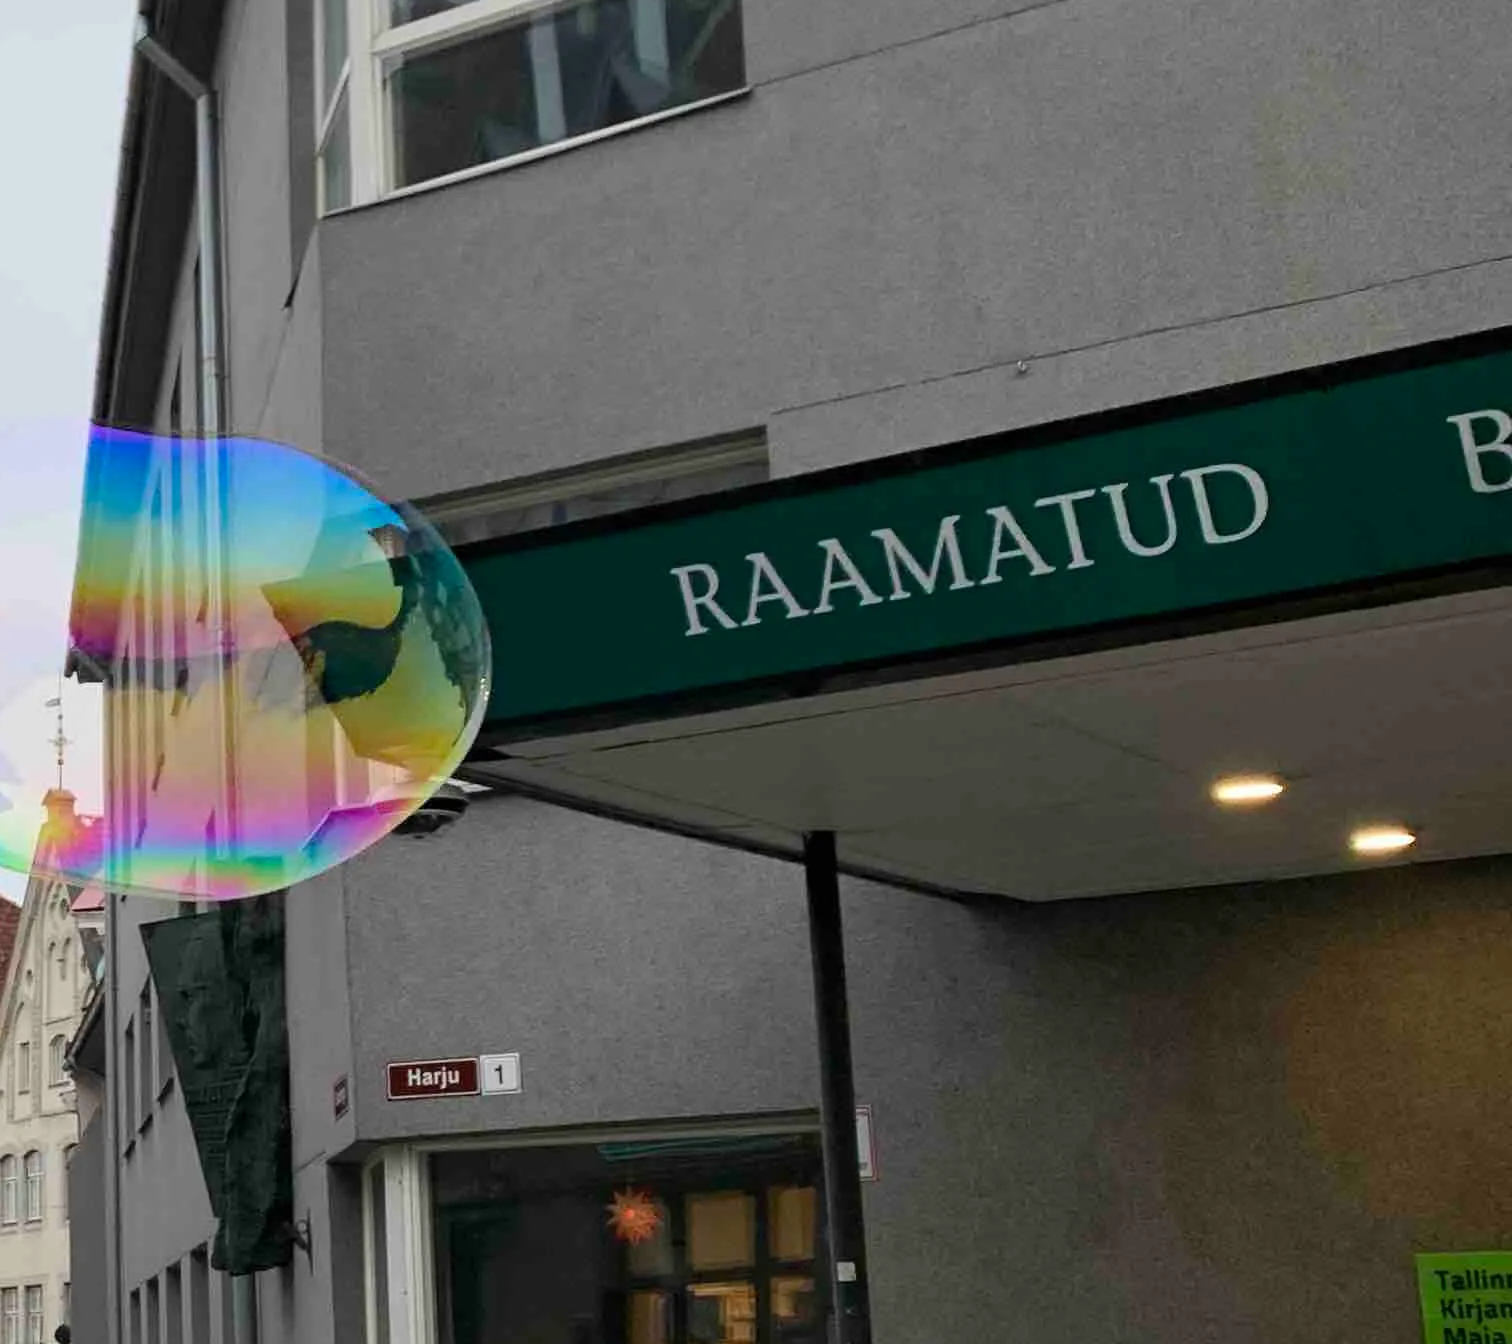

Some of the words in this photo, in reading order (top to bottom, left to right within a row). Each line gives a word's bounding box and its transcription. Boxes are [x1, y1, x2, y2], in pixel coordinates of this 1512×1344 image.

[670, 463, 1270, 638] RAAMATUD
[1445, 408, 1512, 494] B
[406, 1065, 461, 1090] Harju
[493, 1063, 504, 1085] 1
